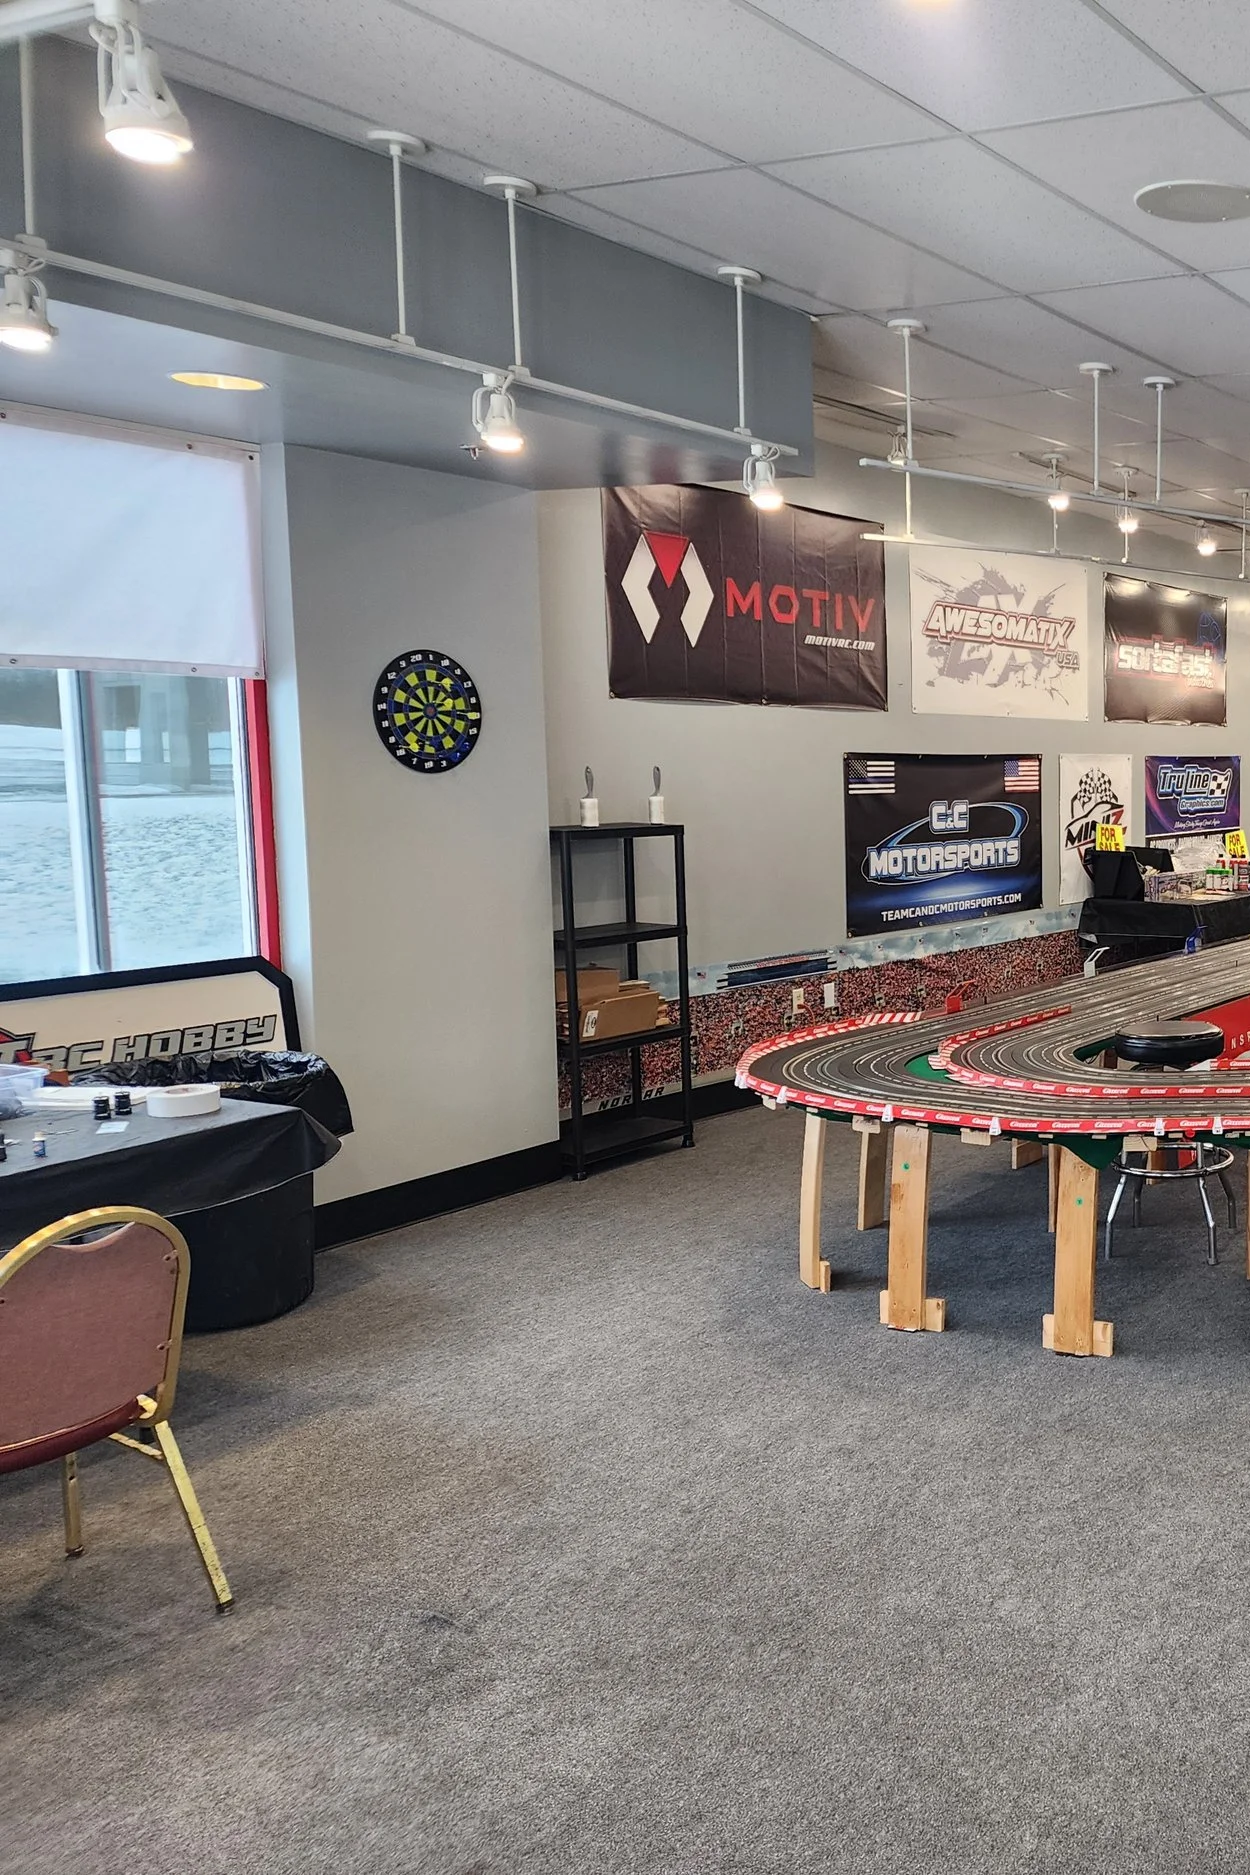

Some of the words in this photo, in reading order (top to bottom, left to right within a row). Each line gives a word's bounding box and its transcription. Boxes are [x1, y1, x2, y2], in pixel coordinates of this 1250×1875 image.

[725, 577, 875, 633] MOTIV
[925, 602, 1074, 651] AWESOMATIX
[410, 654, 422, 662] 20
[1057, 652, 1080, 668] USA
[931, 803, 968, 830] C&C
[1100, 826, 1117, 842] FOR
[1228, 834, 1241, 846] FOR
[869, 839, 1020, 878] MOTORSPORTS
[881, 893, 1022, 922] TEAMCANDCMOTORSPORTS.COM
[31, 1040, 104, 1073] RC
[112, 1014, 277, 1064] HOBBY
